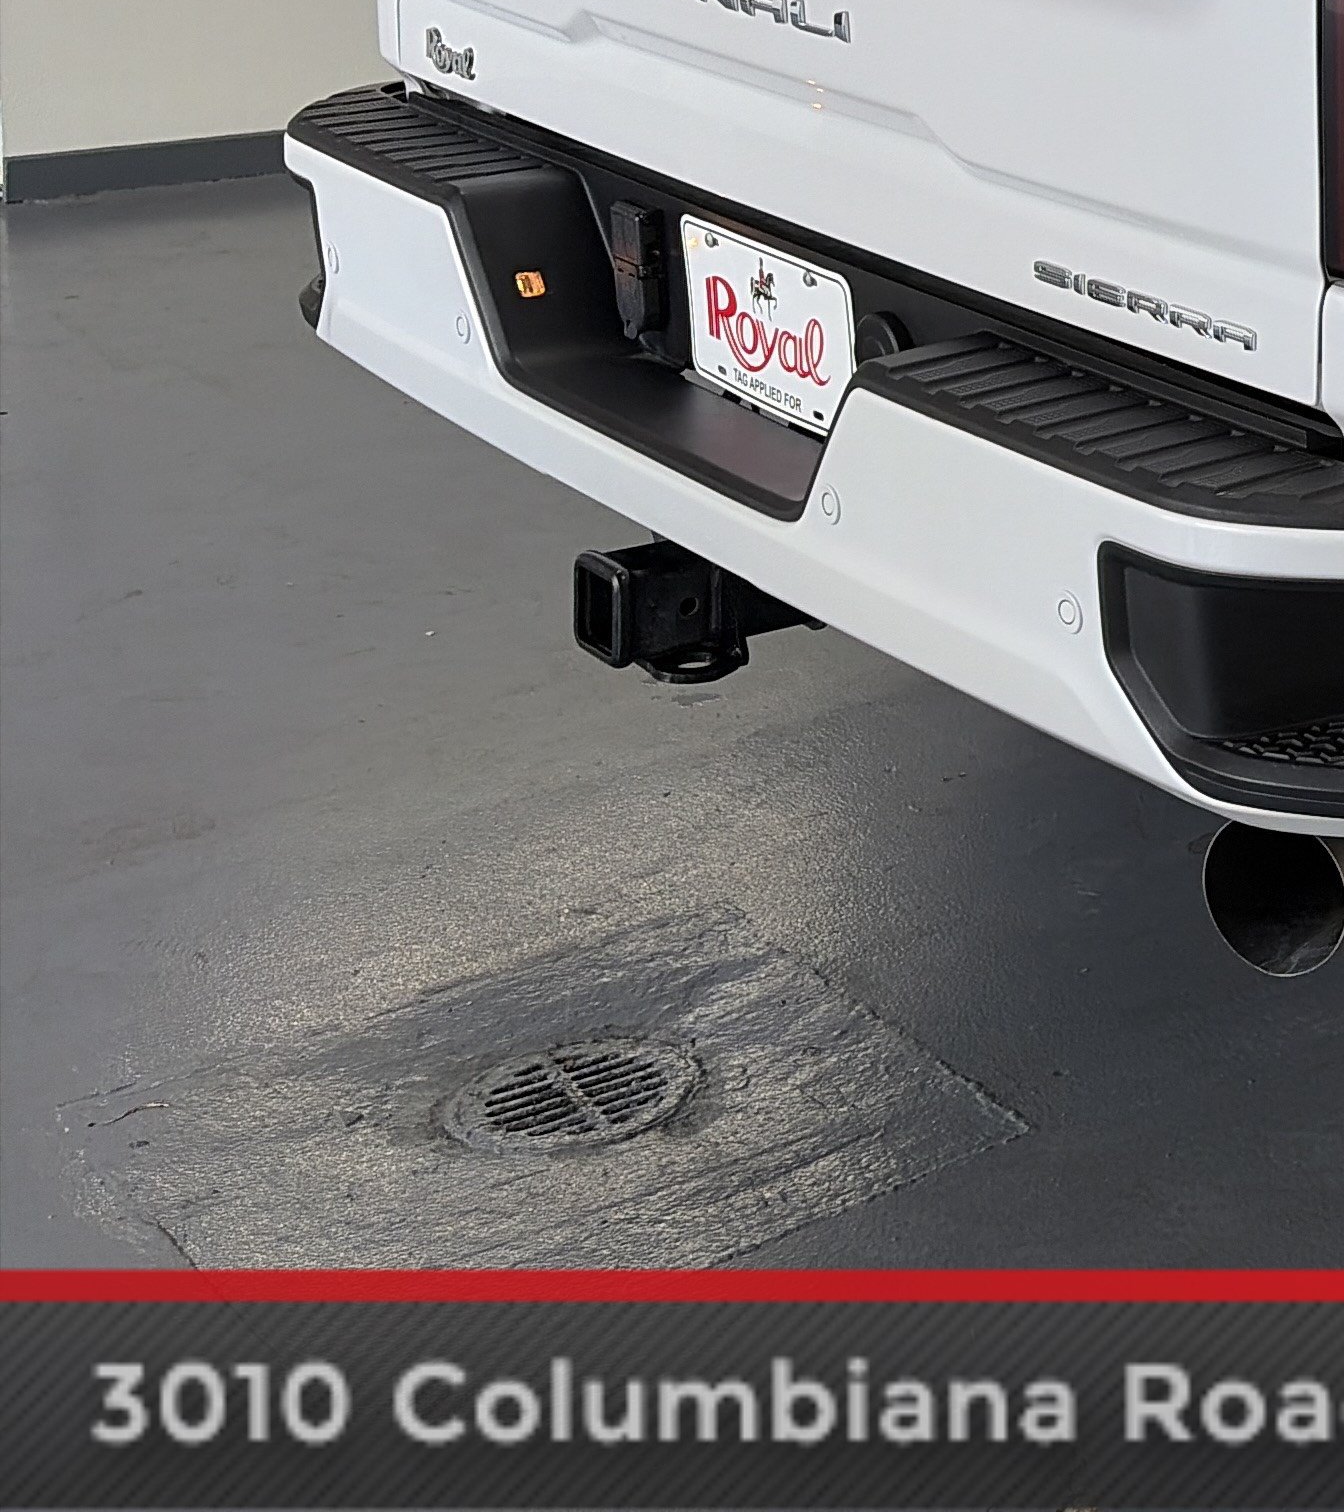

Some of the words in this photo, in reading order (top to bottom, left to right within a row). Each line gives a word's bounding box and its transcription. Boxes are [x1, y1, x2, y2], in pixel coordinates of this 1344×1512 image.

[426, 27, 476, 80] Royal
[705, 275, 831, 386] Royal
[1033, 260, 1258, 352] SIERRA
[733, 367, 749, 386] TAG
[749, 378, 782, 404] APPLIED
[784, 393, 802, 412] FOR
